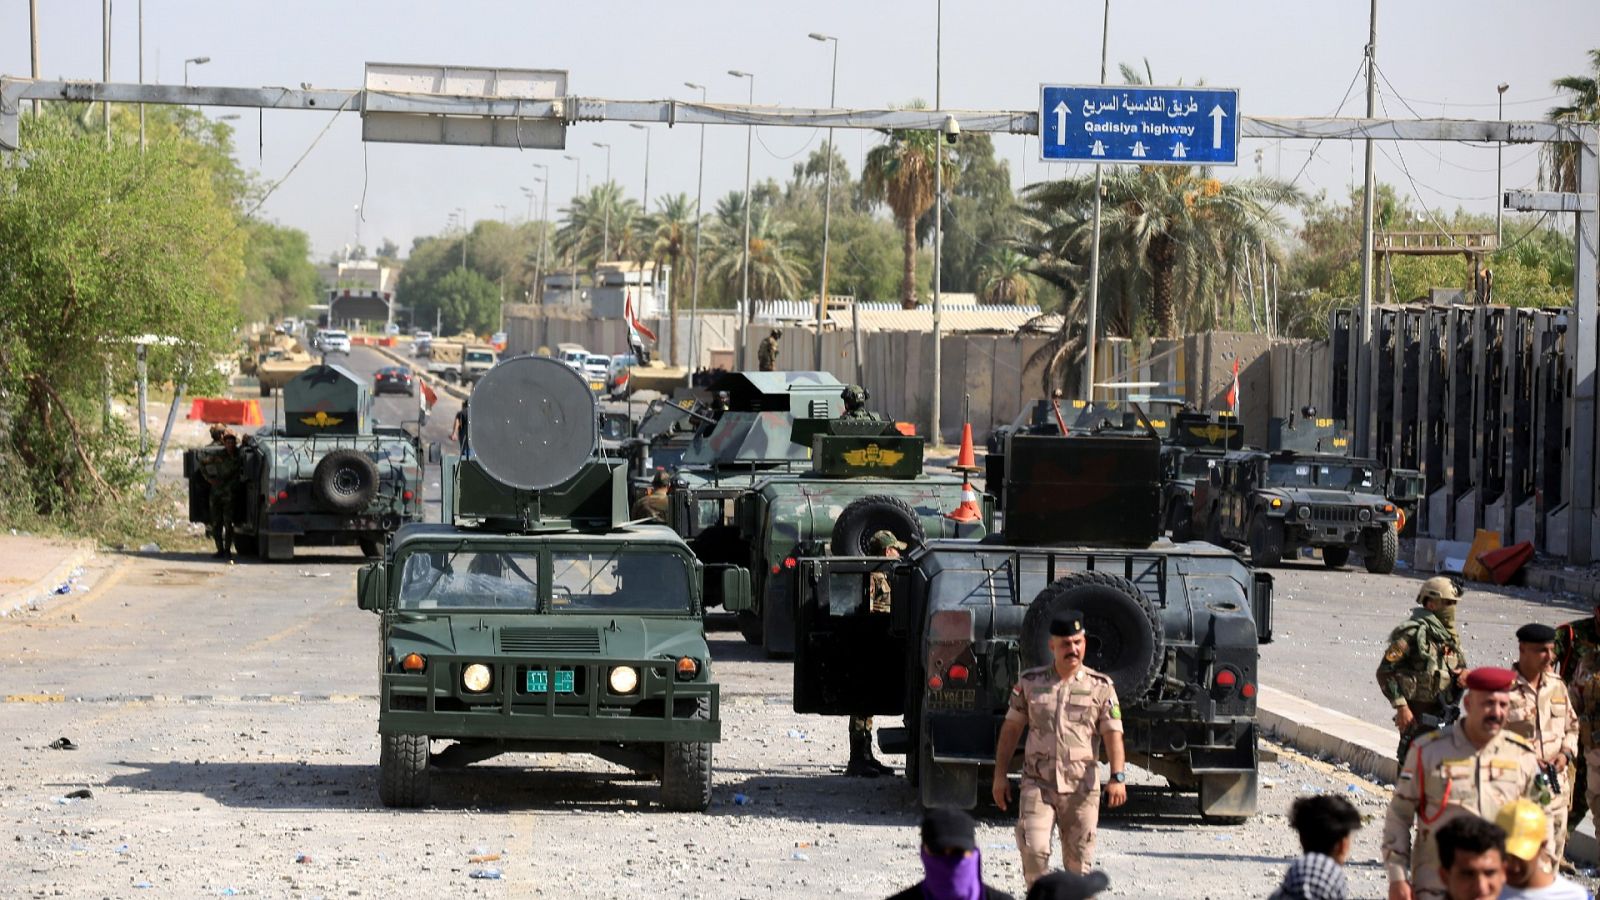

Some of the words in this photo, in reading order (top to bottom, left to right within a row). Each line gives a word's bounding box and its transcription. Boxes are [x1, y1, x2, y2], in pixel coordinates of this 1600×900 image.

[1082, 95, 1119, 117] السريع
[1122, 94, 1165, 116] القادسية
[1167, 96, 1198, 117] طريق
[1084, 121, 1138, 135] Qadisiya
[1142, 121, 1195, 137] highway
[1315, 418, 1335, 428] ISF
